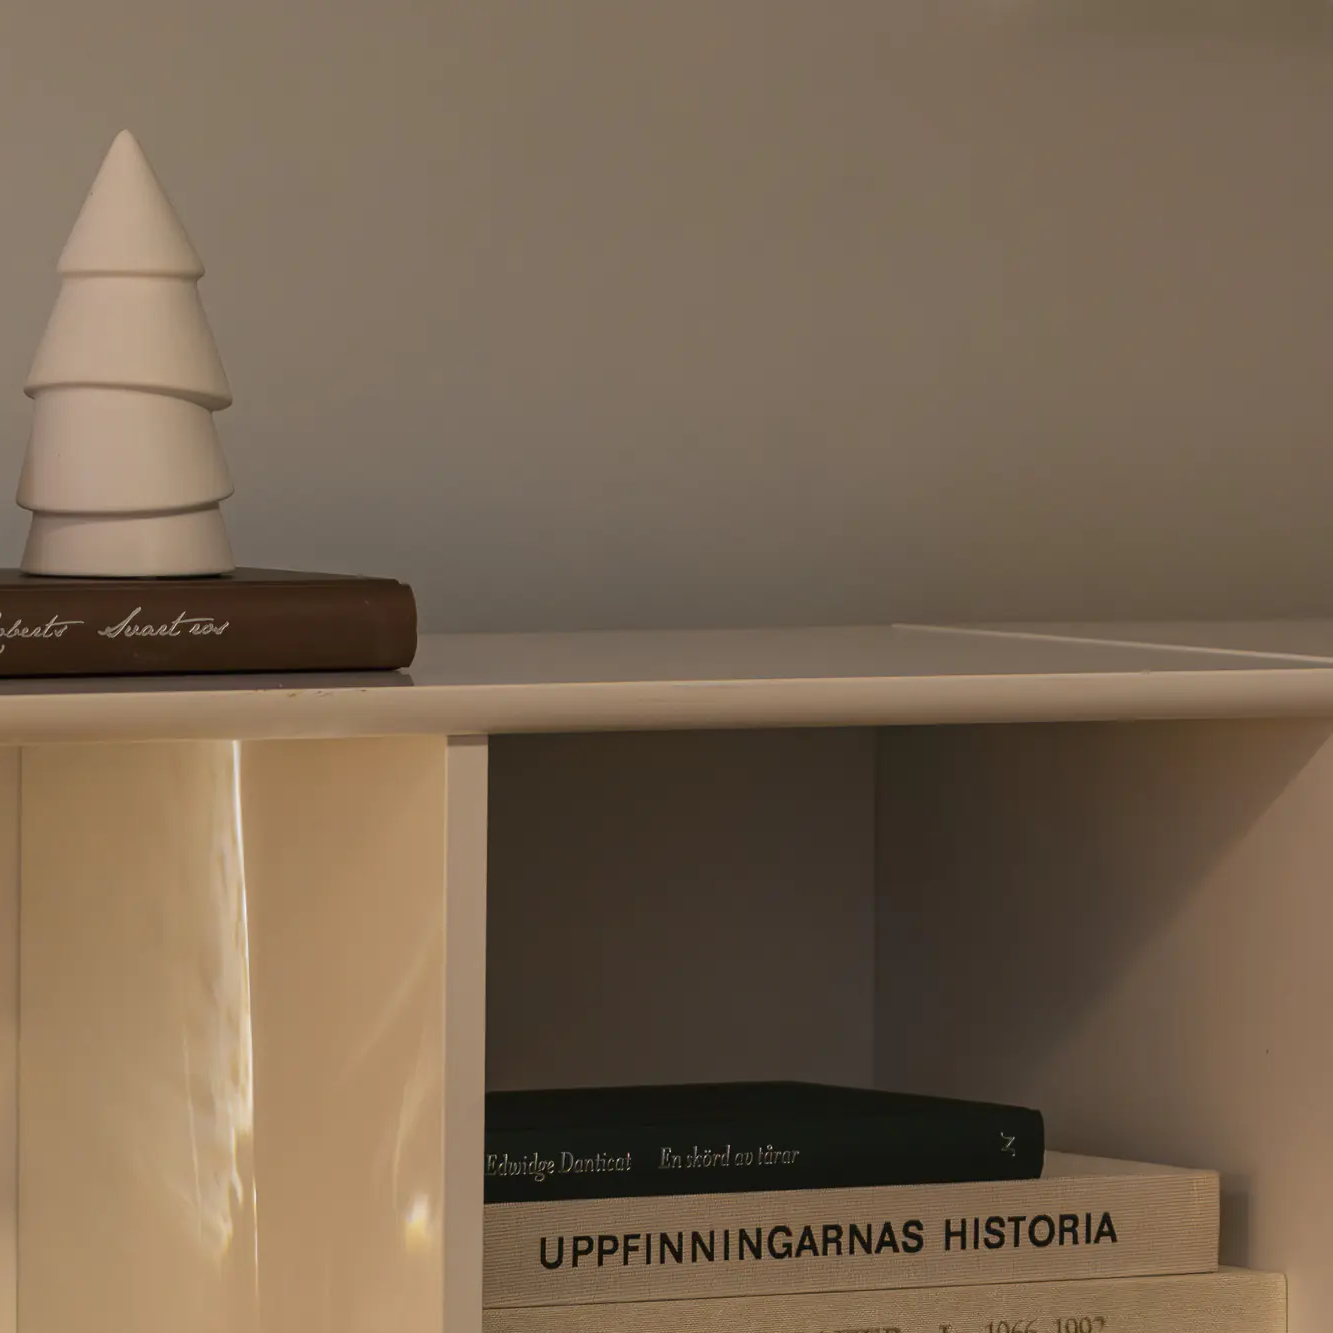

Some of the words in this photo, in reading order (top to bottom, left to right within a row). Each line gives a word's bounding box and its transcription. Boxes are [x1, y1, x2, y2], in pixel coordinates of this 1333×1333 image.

[485, 1152, 555, 1182] Edwidge
[558, 1151, 632, 1174] Danticat
[658, 1147, 682, 1169] En
[686, 1145, 731, 1168] skörd
[734, 1151, 754, 1166] av
[758, 1144, 800, 1165] tårar
[540, 1219, 924, 1270] UPPFINNINGARNAS
[945, 1211, 1118, 1251] HISTORIA
